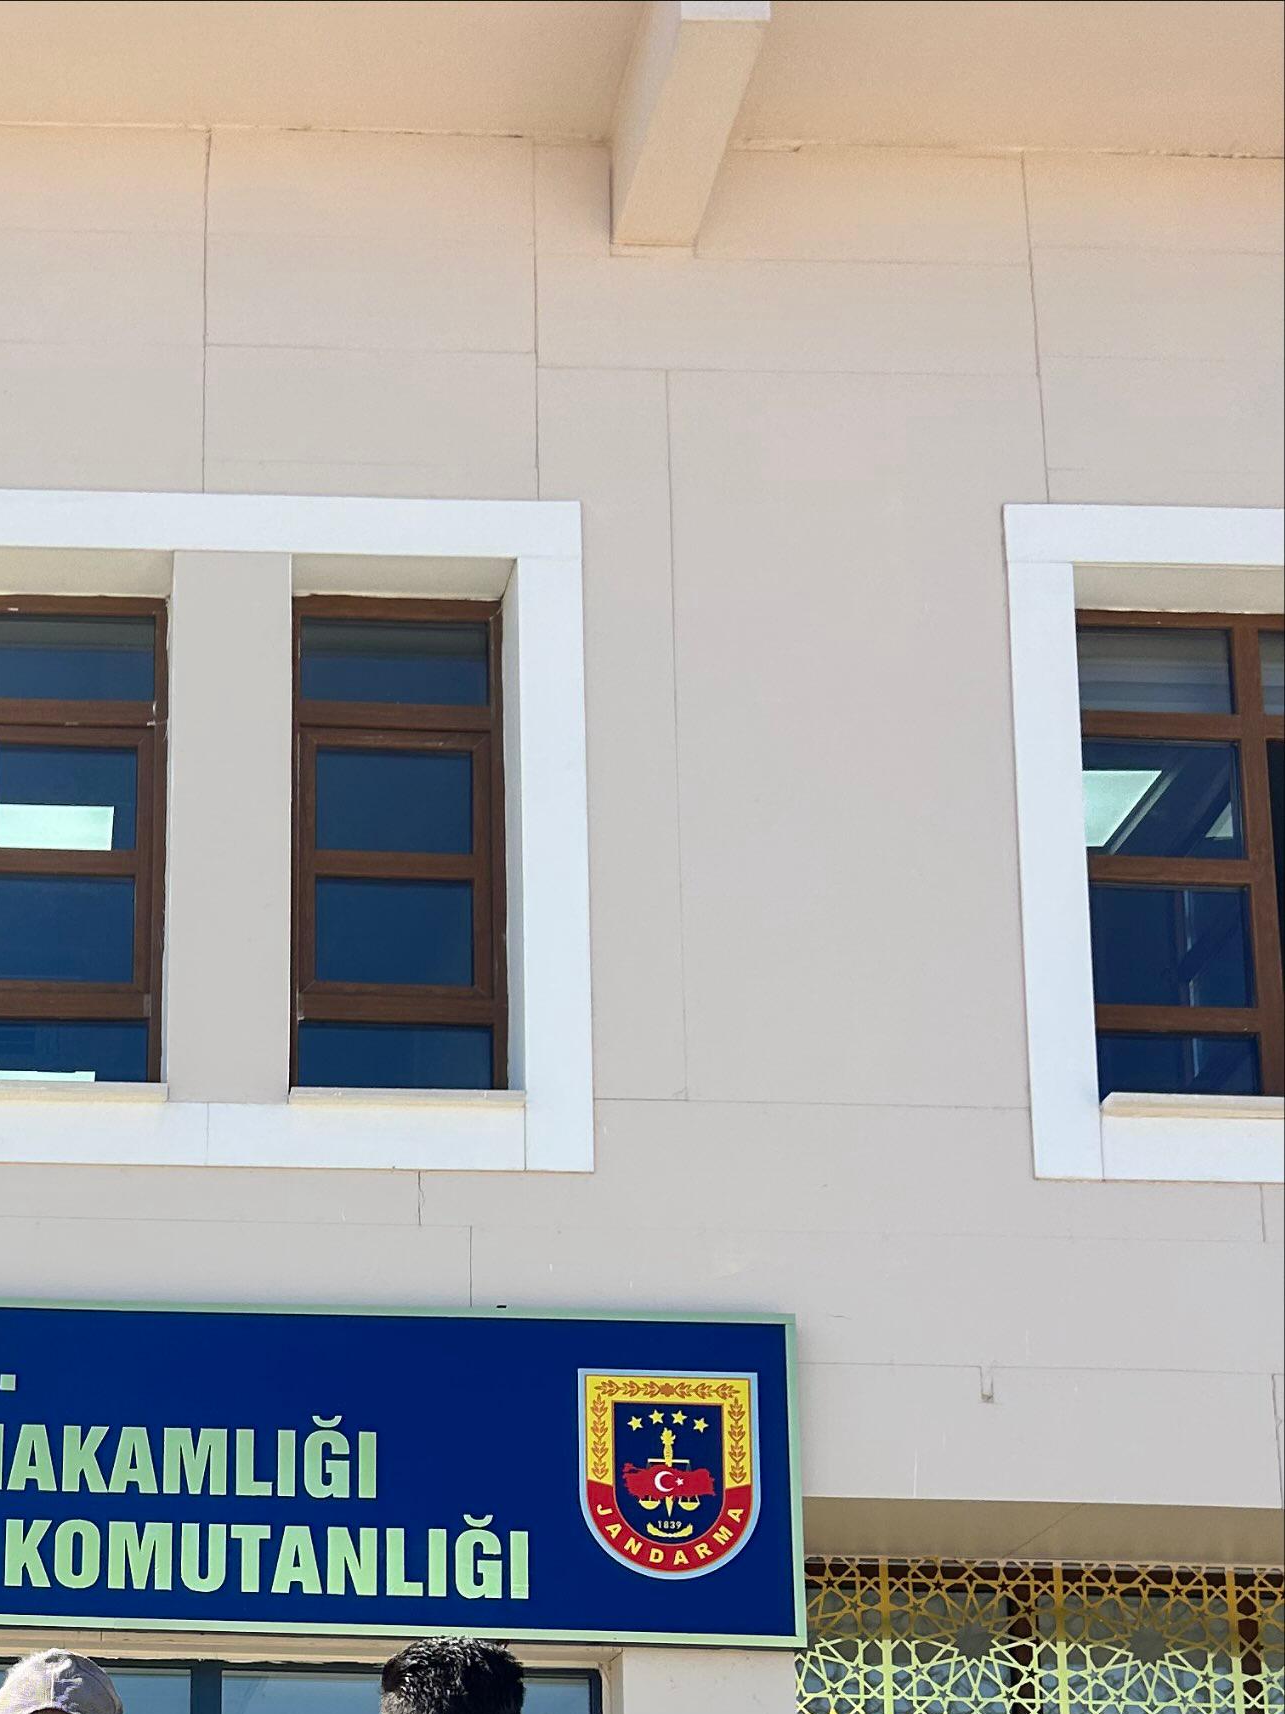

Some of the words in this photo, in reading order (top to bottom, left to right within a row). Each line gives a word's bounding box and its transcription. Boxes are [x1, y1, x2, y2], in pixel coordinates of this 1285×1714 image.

[596, 1503, 745, 1566] JANDARMA
[657, 1519, 682, 1530] 1839
[4, 1514, 531, 1601] KOMUTANLIĞI
